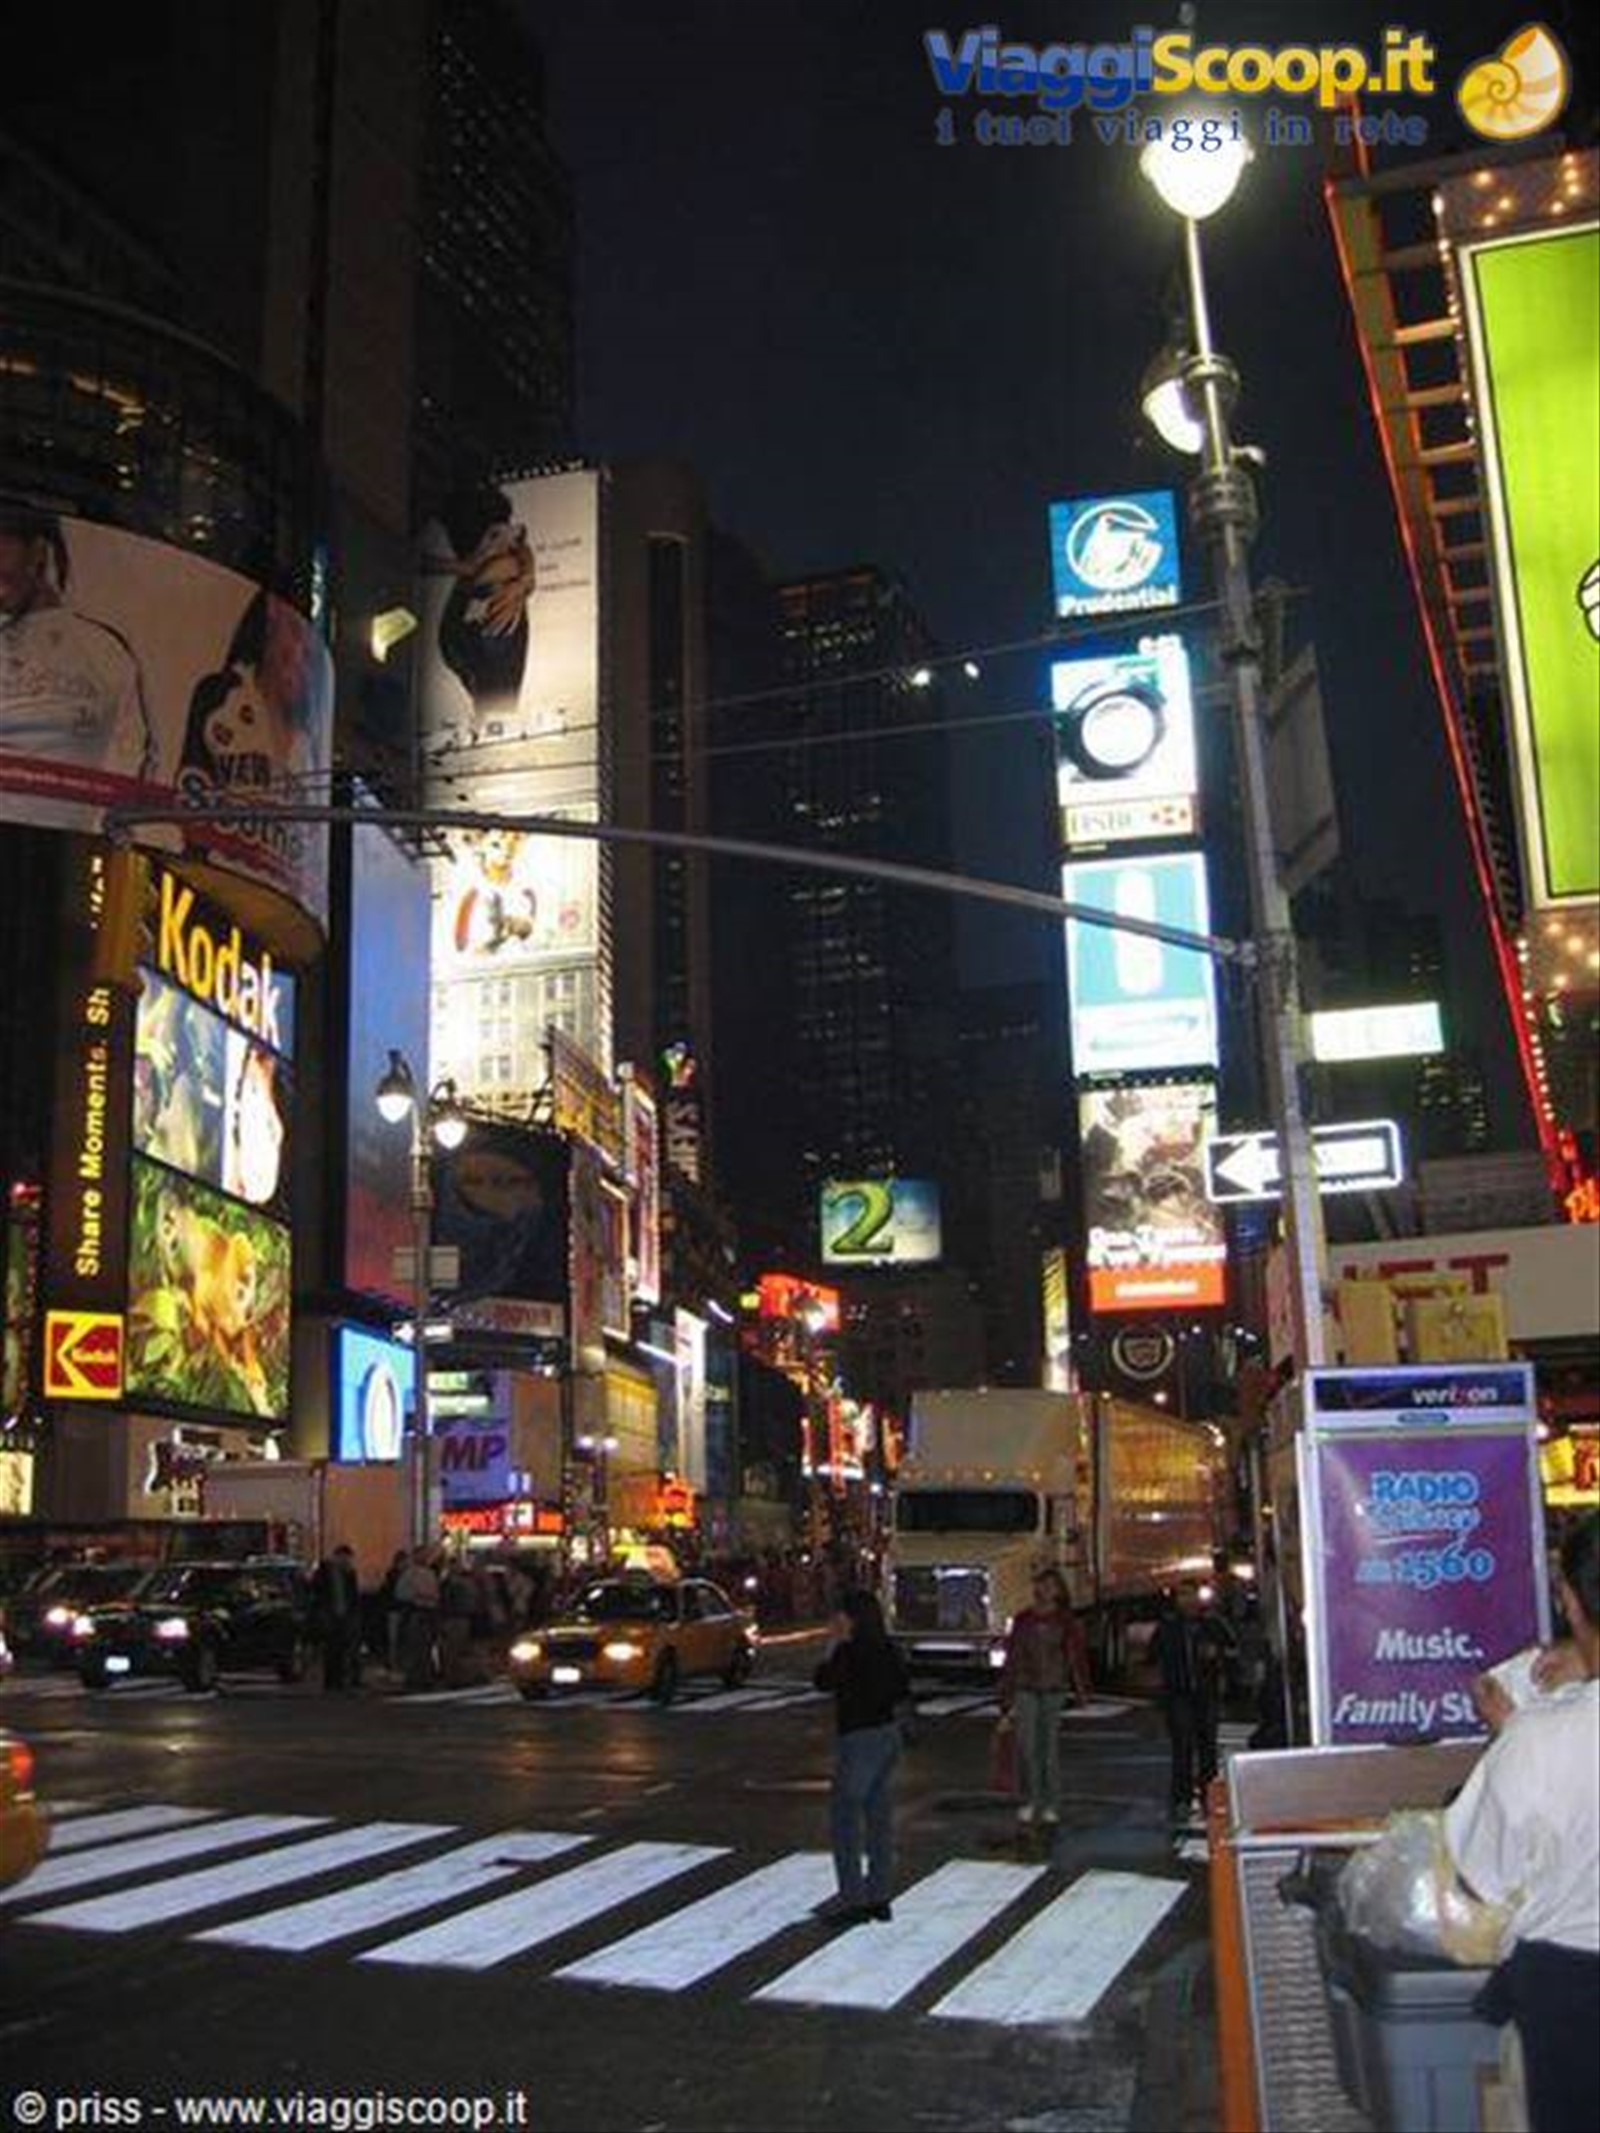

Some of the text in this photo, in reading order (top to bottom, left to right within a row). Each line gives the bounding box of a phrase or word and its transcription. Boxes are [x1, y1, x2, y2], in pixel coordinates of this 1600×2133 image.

[159, 872, 282, 1052] Kodak
[86, 985, 110, 1026] Sh
[75, 1189, 101, 1278] Share
[829, 1181, 895, 1254] 2
[1370, 1470, 1481, 1505] RADIO
[1375, 1627, 1486, 1660] Music.
[1333, 1691, 1480, 1734] Family St
